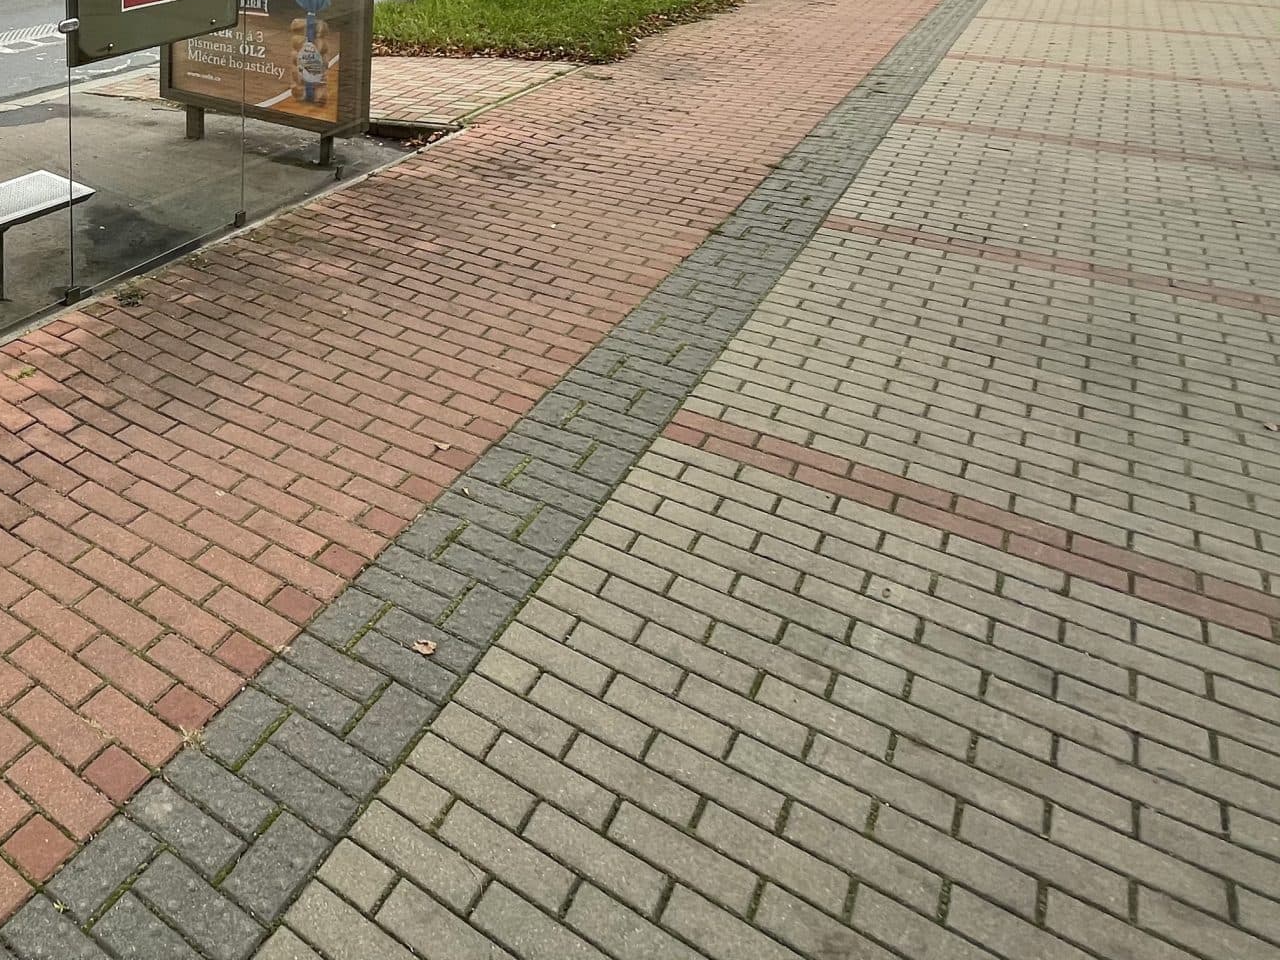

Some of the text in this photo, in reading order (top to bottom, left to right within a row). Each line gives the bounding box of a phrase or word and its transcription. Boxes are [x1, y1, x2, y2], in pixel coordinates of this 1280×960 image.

[255, 30, 264, 43] 3
[188, 49, 227, 67] Mléčné
[239, 40, 266, 58] ÖLZ
